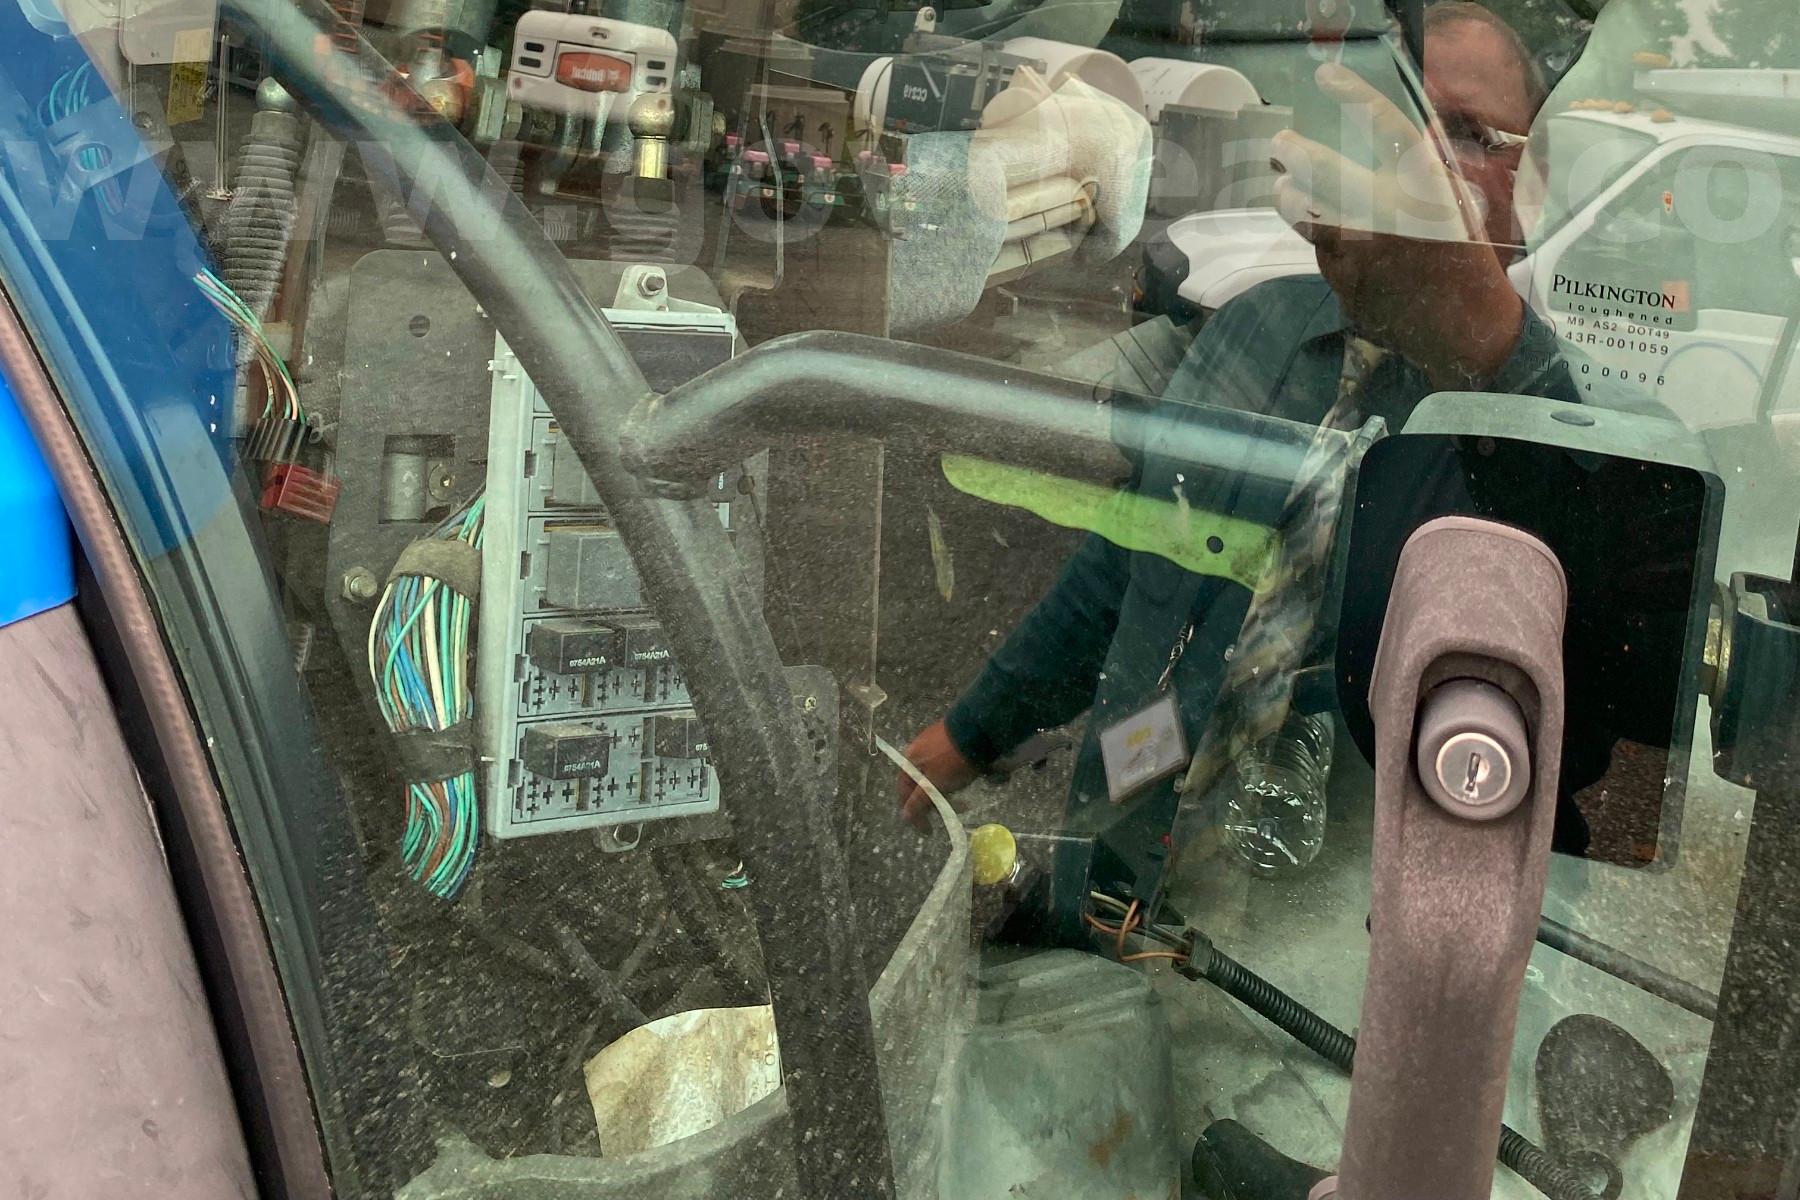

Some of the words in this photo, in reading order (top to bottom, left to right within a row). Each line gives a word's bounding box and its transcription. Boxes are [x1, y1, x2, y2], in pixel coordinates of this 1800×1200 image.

[1567, 316, 1585, 327] M9
[1593, 320, 1618, 332] AS2
[1628, 324, 1670, 339] DOT49
[1565, 331, 1669, 355] 43R-001059
